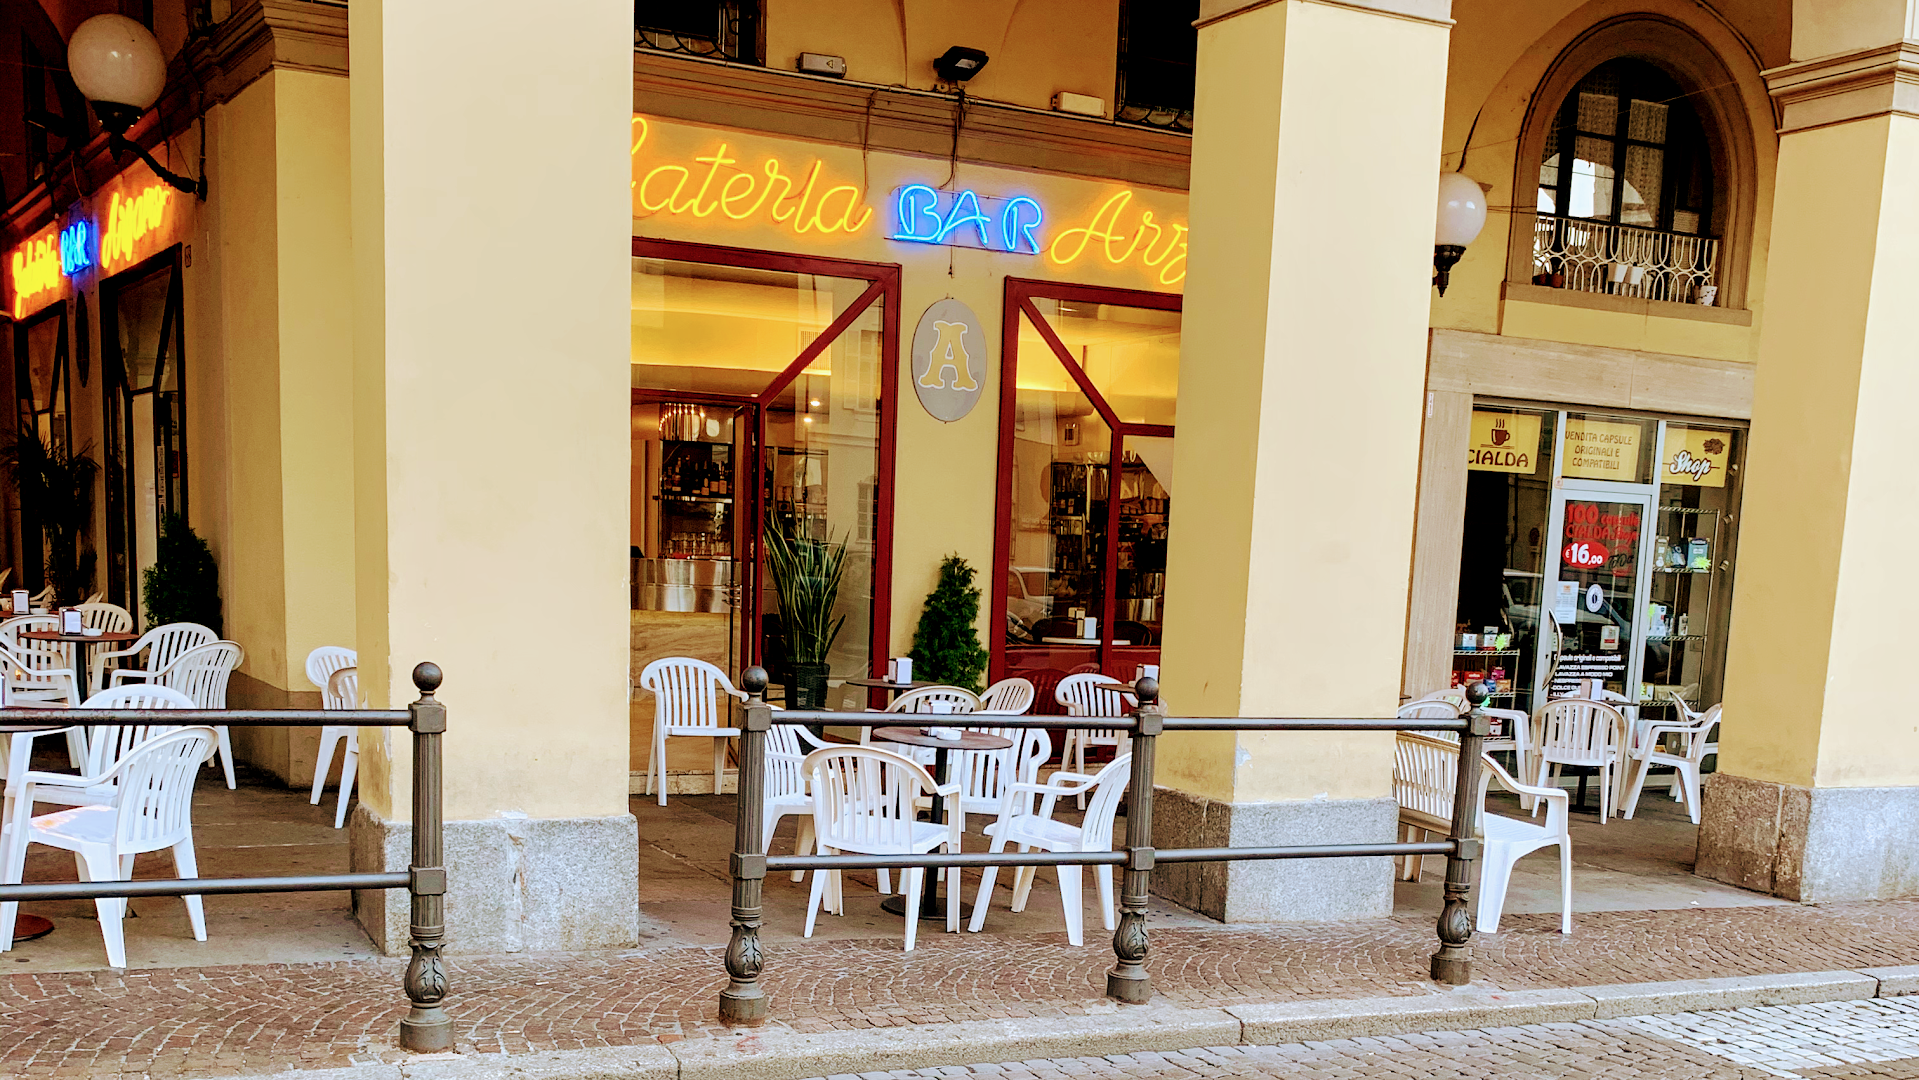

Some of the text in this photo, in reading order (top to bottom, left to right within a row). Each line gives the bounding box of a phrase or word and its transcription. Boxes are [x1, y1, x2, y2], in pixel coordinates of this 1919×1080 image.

[892, 183, 1040, 256] BAR
[918, 320, 979, 392] A
[1565, 430, 1633, 446] VENDITA CAPSULE
[1468, 449, 1529, 468] CIALDA
[1574, 445, 1620, 458] ORIGINALI E
[1572, 457, 1620, 470] COMPATIBILI
[1669, 450, 1712, 482] Shop
[1567, 503, 1599, 525] 100
[1565, 524, 1610, 540] CIALDA
[1554, 654, 1574, 662] Cpsule
